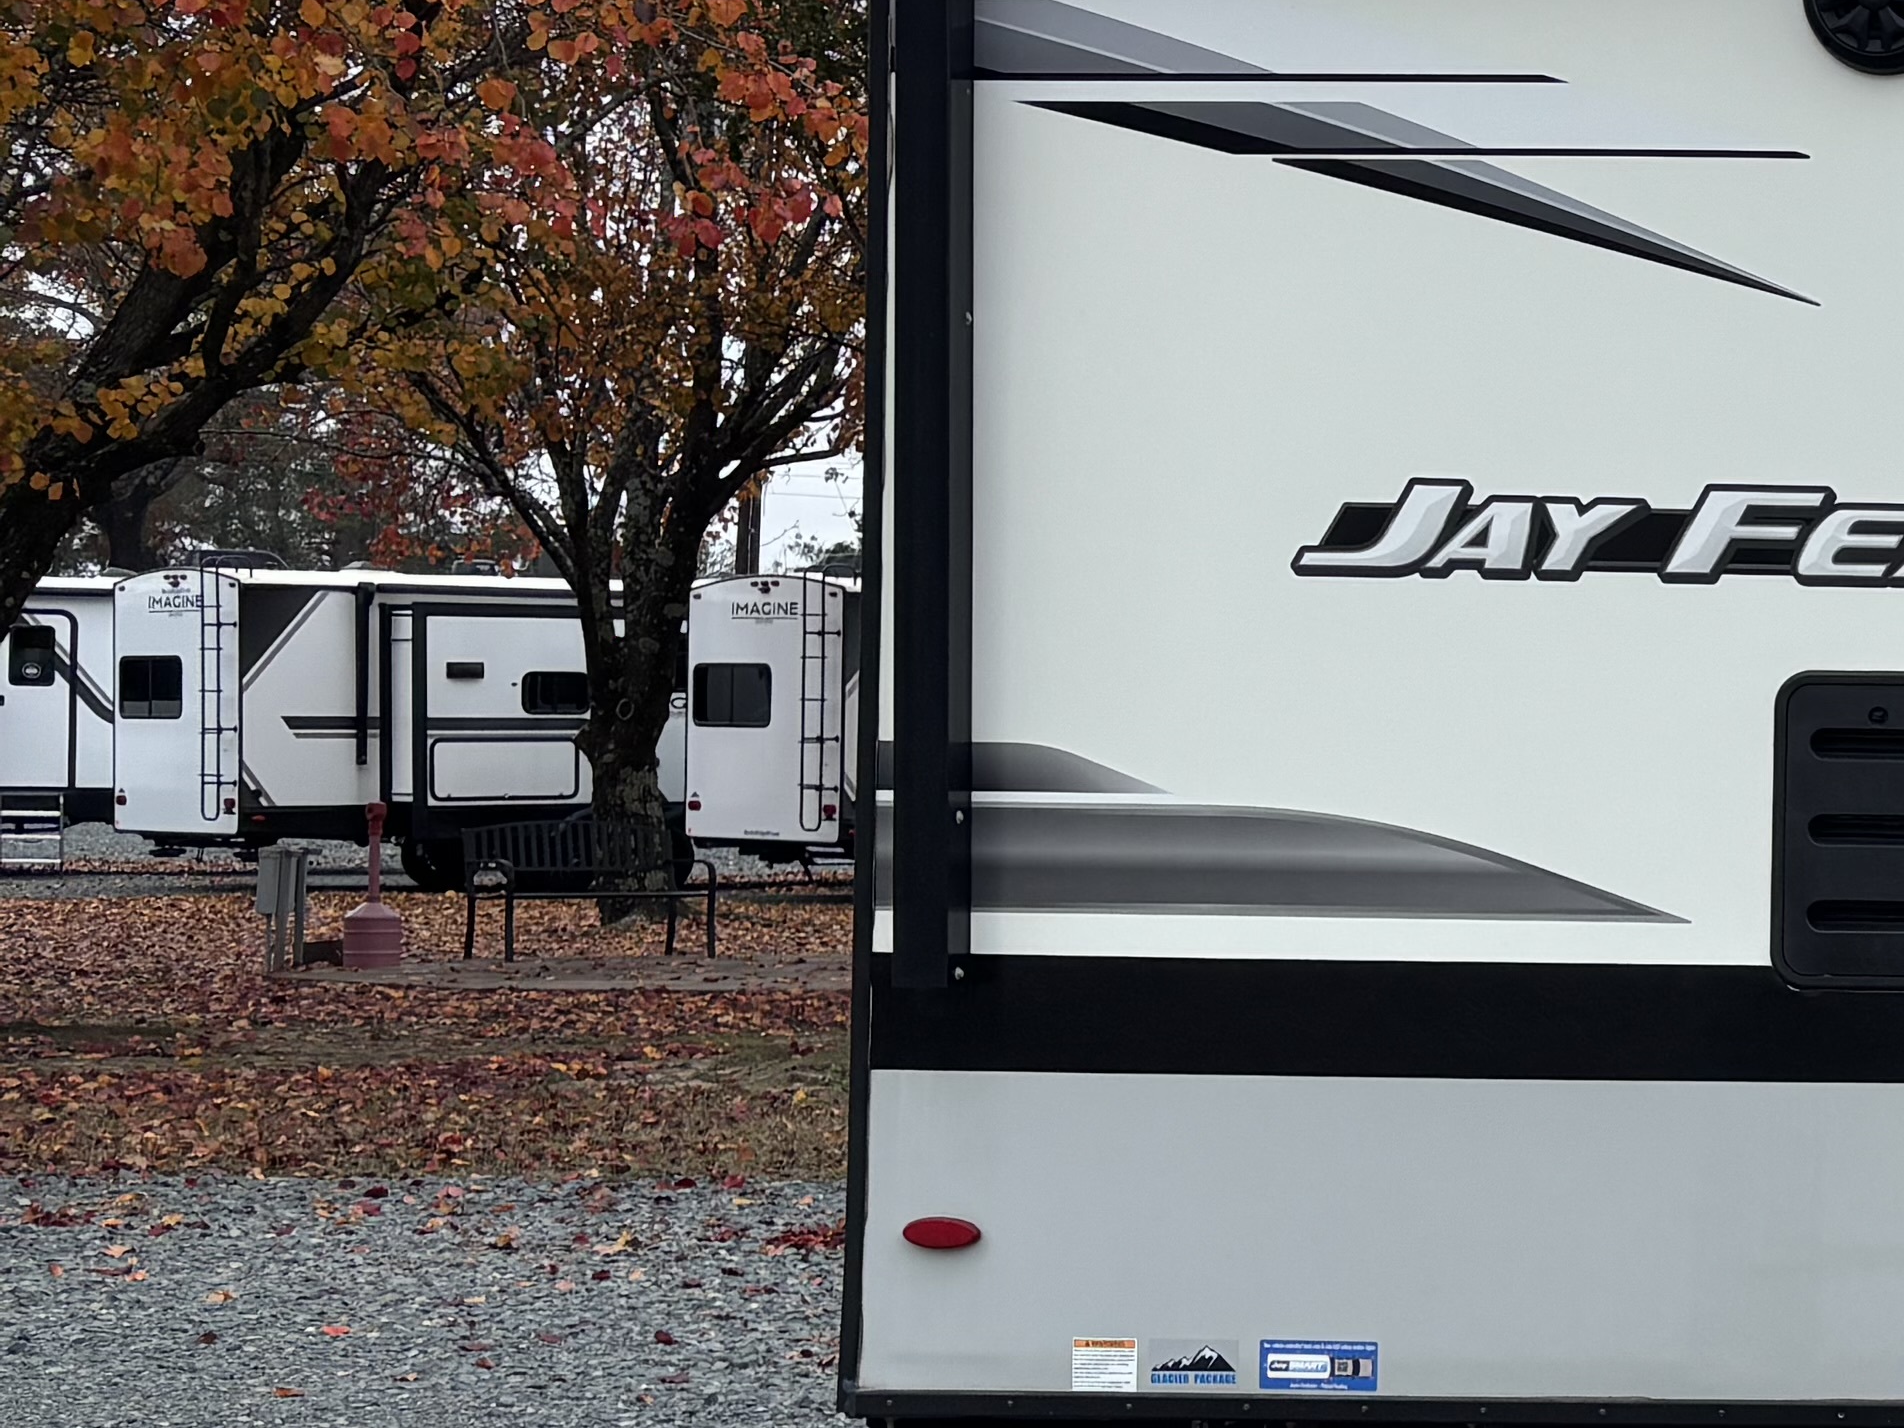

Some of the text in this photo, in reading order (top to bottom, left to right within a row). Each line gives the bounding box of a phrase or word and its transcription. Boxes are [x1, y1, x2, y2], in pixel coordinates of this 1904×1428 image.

[1295, 478, 1648, 579] JAY
[148, 594, 203, 609] IMAGINE
[731, 601, 799, 615] IMAGINE
[1194, 1373, 1237, 1385] PACKAGE
